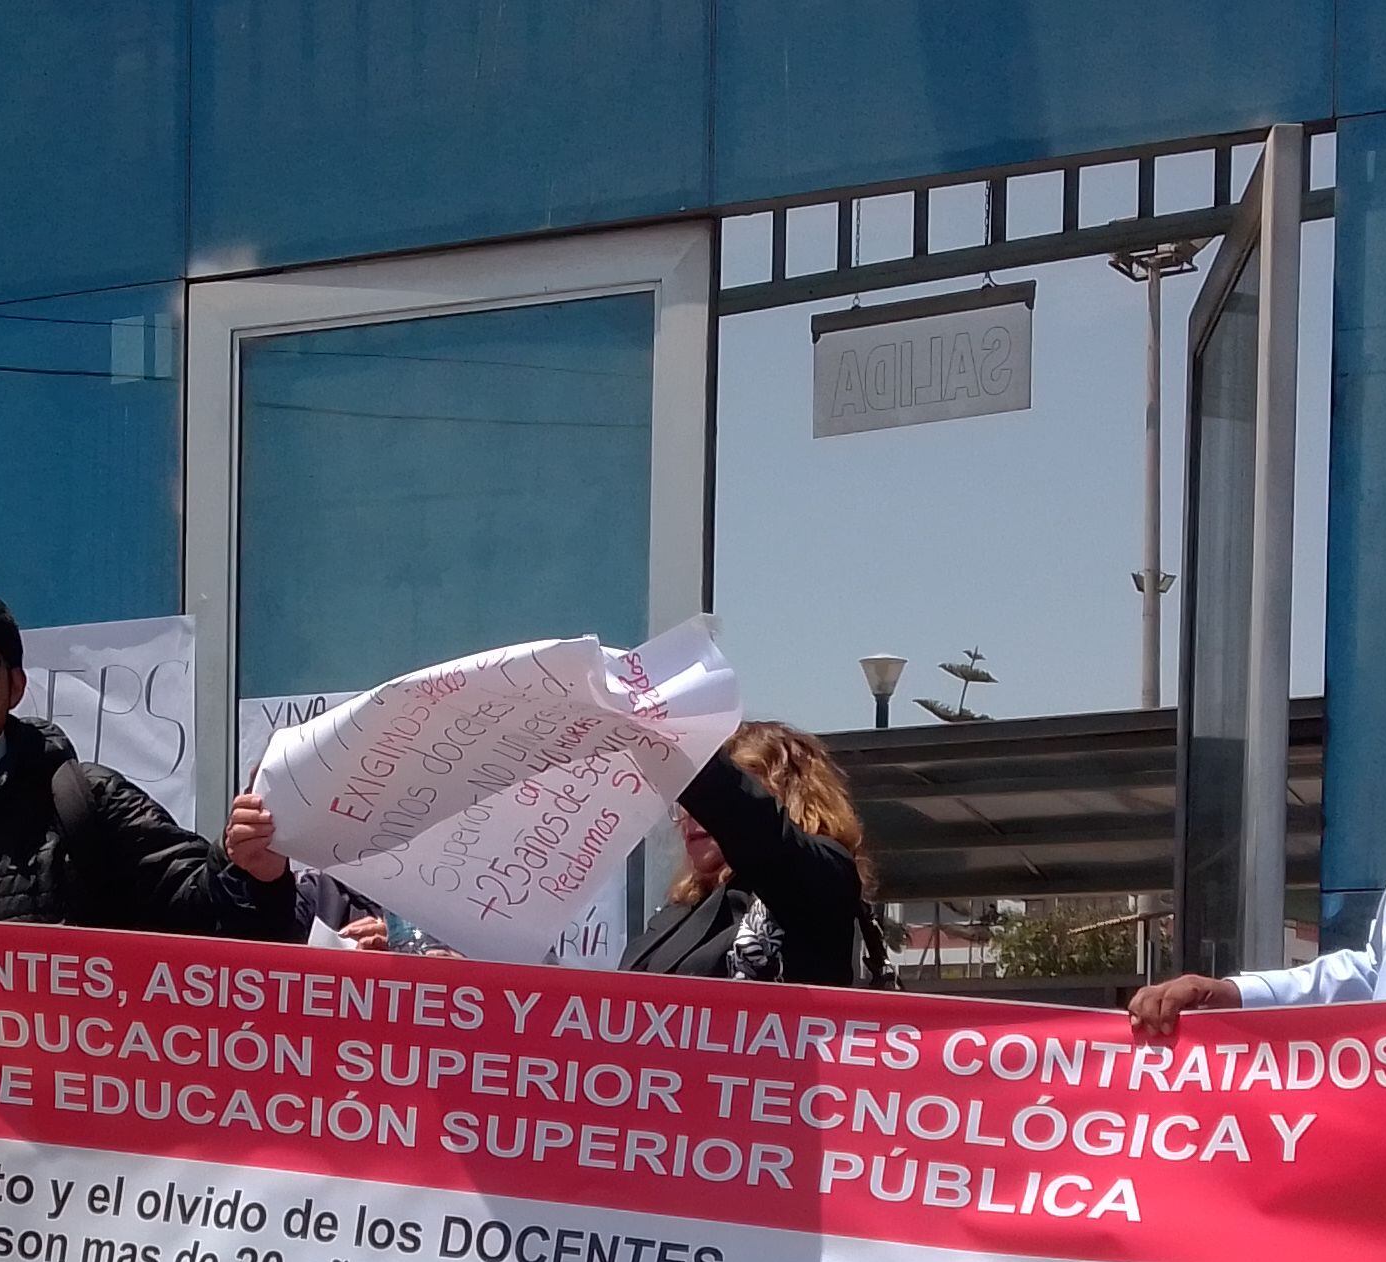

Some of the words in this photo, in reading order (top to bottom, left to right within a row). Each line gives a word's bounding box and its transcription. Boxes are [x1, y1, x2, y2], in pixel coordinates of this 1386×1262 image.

[328, 700, 432, 824] EXIGIMOS
[333, 785, 438, 881] Somos
[549, 905, 609, 959] RÍA
[142, 962, 486, 1031] ASISTENTES
[503, 989, 543, 1035] Y
[551, 996, 921, 1072] AUXILIARES
[52, 1070, 418, 1149] EDUCACIÓN
[438, 1108, 796, 1191] SUPERIOR
[816, 1146, 1144, 1223] PÚBLICA
[334, 1038, 684, 1114] SUPERIOR
[706, 1073, 1253, 1163] TECNOLÓGICA
[1267, 1112, 1318, 1163] Y
[48, 1177, 76, 1221] y
[86, 1175, 125, 1218] el
[135, 1184, 269, 1236] olvido
[280, 1197, 341, 1244] de
[355, 1203, 424, 1256] los
